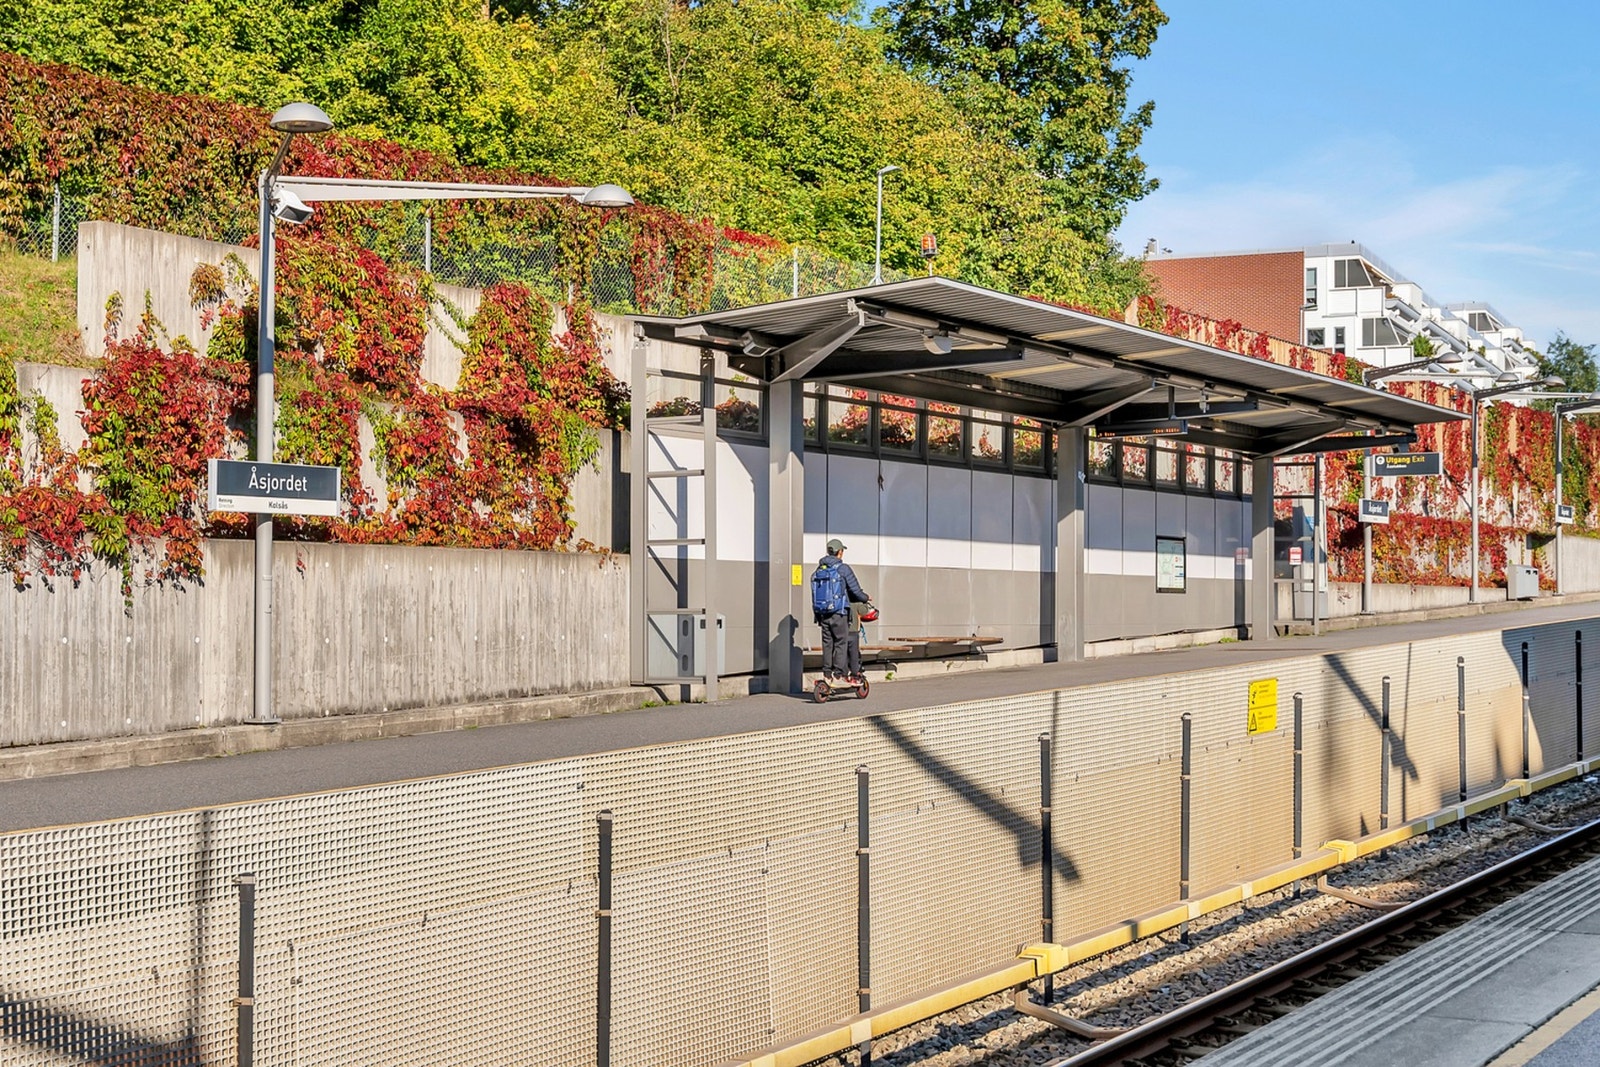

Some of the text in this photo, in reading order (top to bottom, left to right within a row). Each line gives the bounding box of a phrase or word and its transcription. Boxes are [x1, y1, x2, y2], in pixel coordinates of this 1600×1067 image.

[1386, 455, 1425, 465] Utgang Exit
[248, 466, 308, 494] Åsjordet
[268, 501, 289, 510] Kolsås
